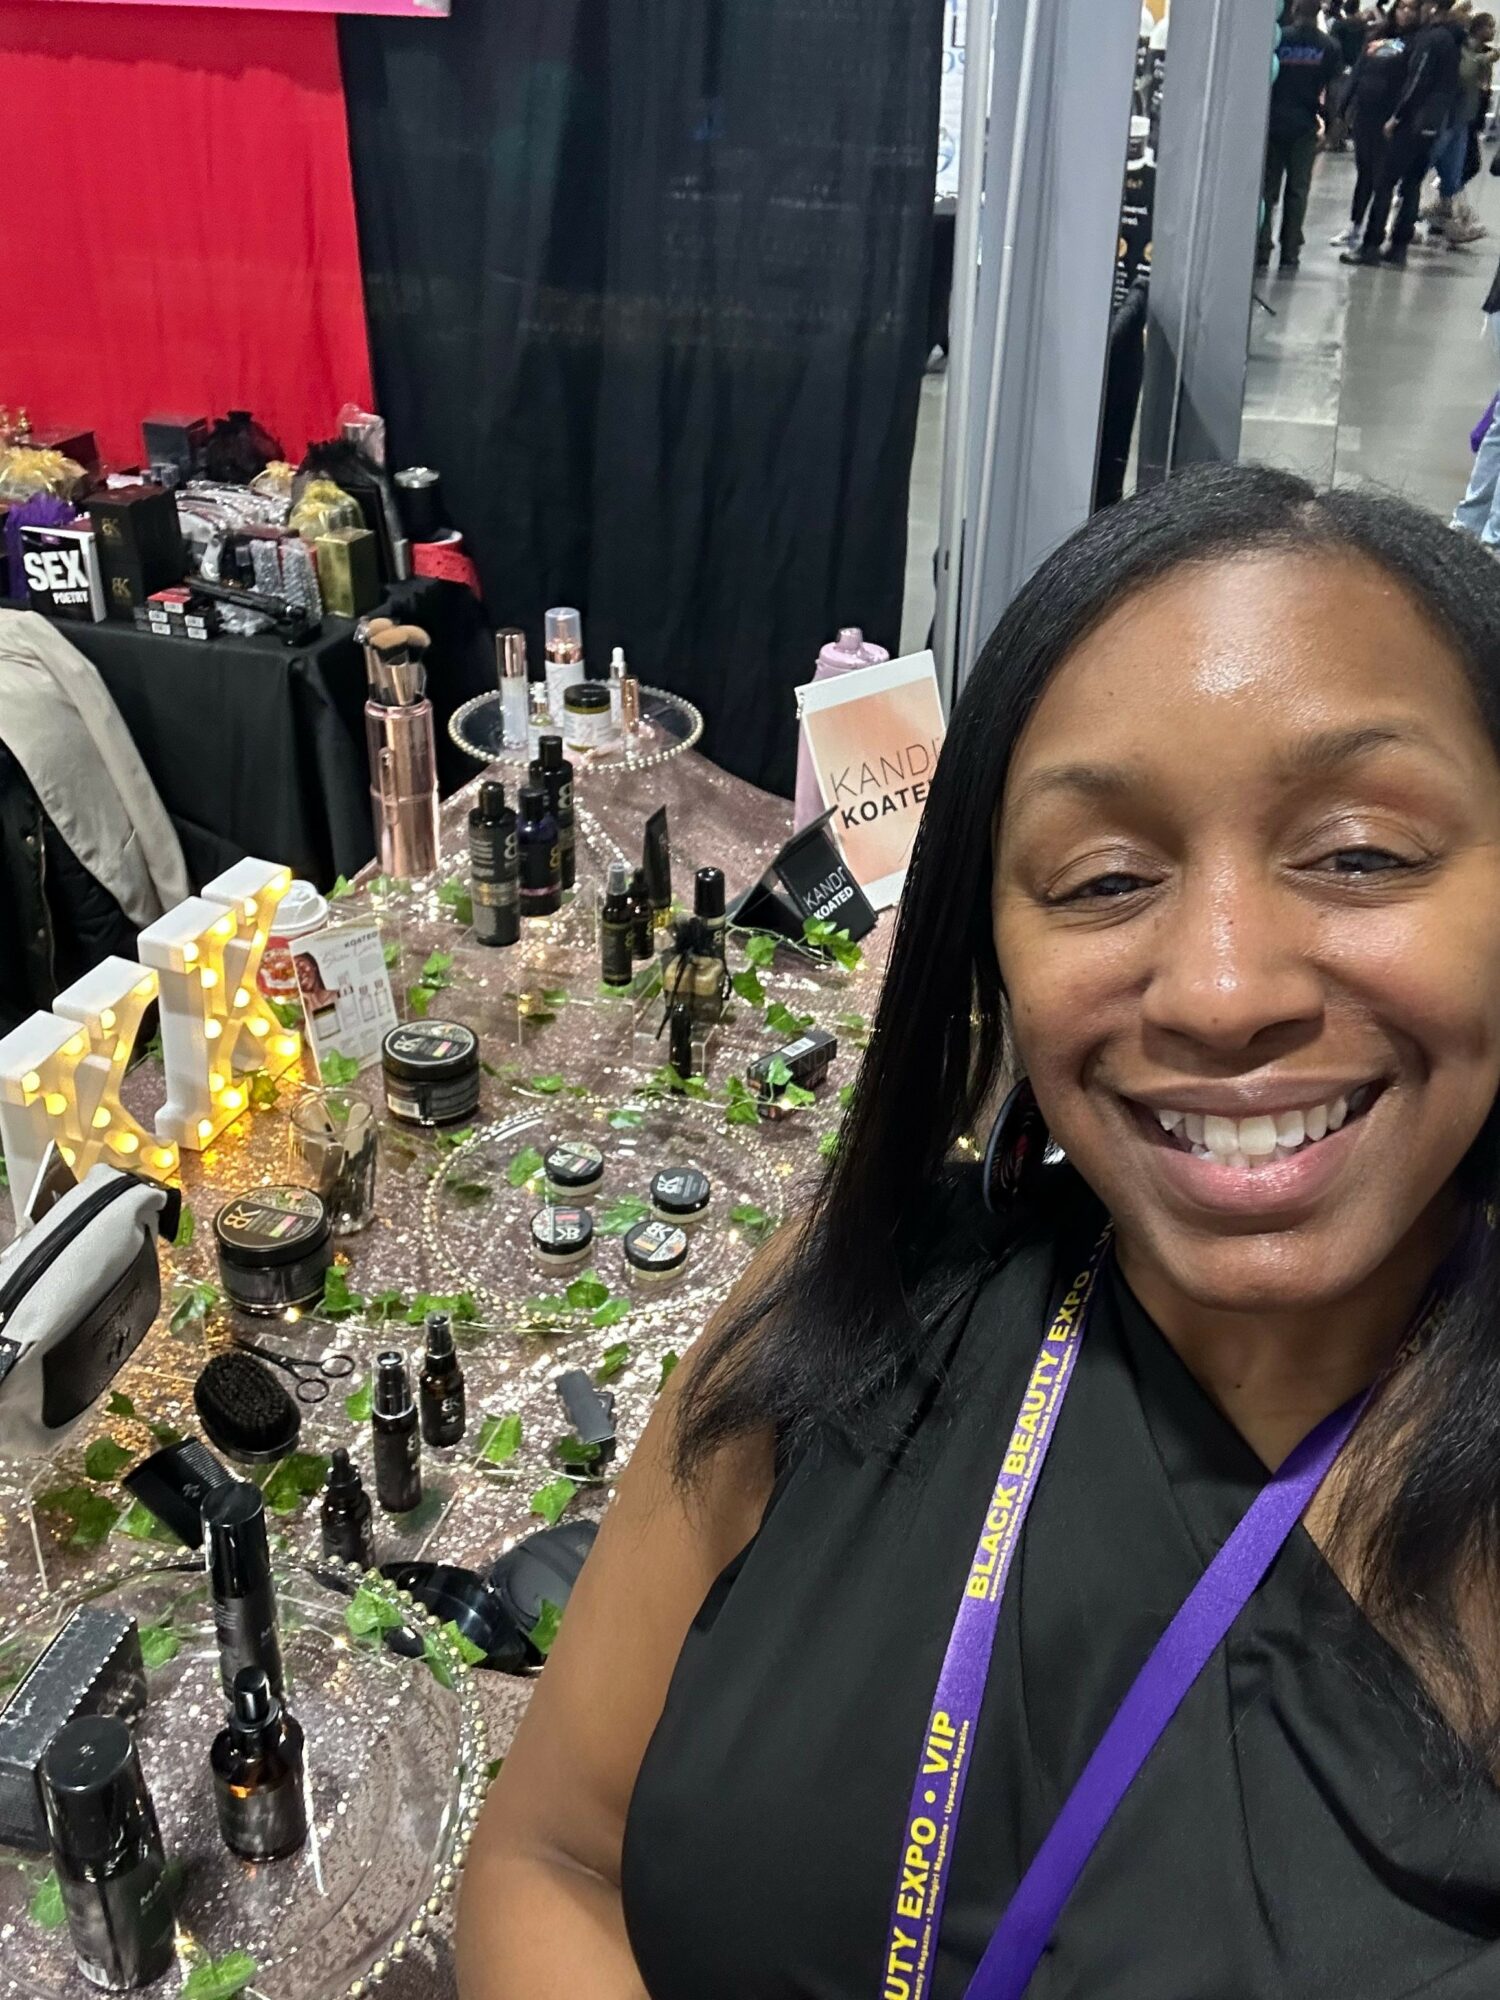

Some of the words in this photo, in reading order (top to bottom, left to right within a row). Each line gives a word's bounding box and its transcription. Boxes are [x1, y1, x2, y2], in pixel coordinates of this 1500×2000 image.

[23, 550, 89, 591] SEX
[52, 590, 89, 605] POETRY
[841, 779, 932, 829] KOATE
[813, 886, 854, 920] KOATED
[344, 931, 378, 949] KOATED
[967, 1483, 1019, 1600] BLACK
[1004, 1350, 1060, 1476] BEAUTY
[1047, 1270, 1090, 1342] EXPO
[896, 1816, 937, 1919] EXPO
[922, 1711, 956, 1774] VIP
[917, 1924, 932, 1972] Magazine
[926, 1874, 941, 1915] Bondgirl
[934, 1824, 949, 1871] Magazine
[944, 1771, 959, 1814] Upscale
[953, 1720, 970, 1769] Magazine
